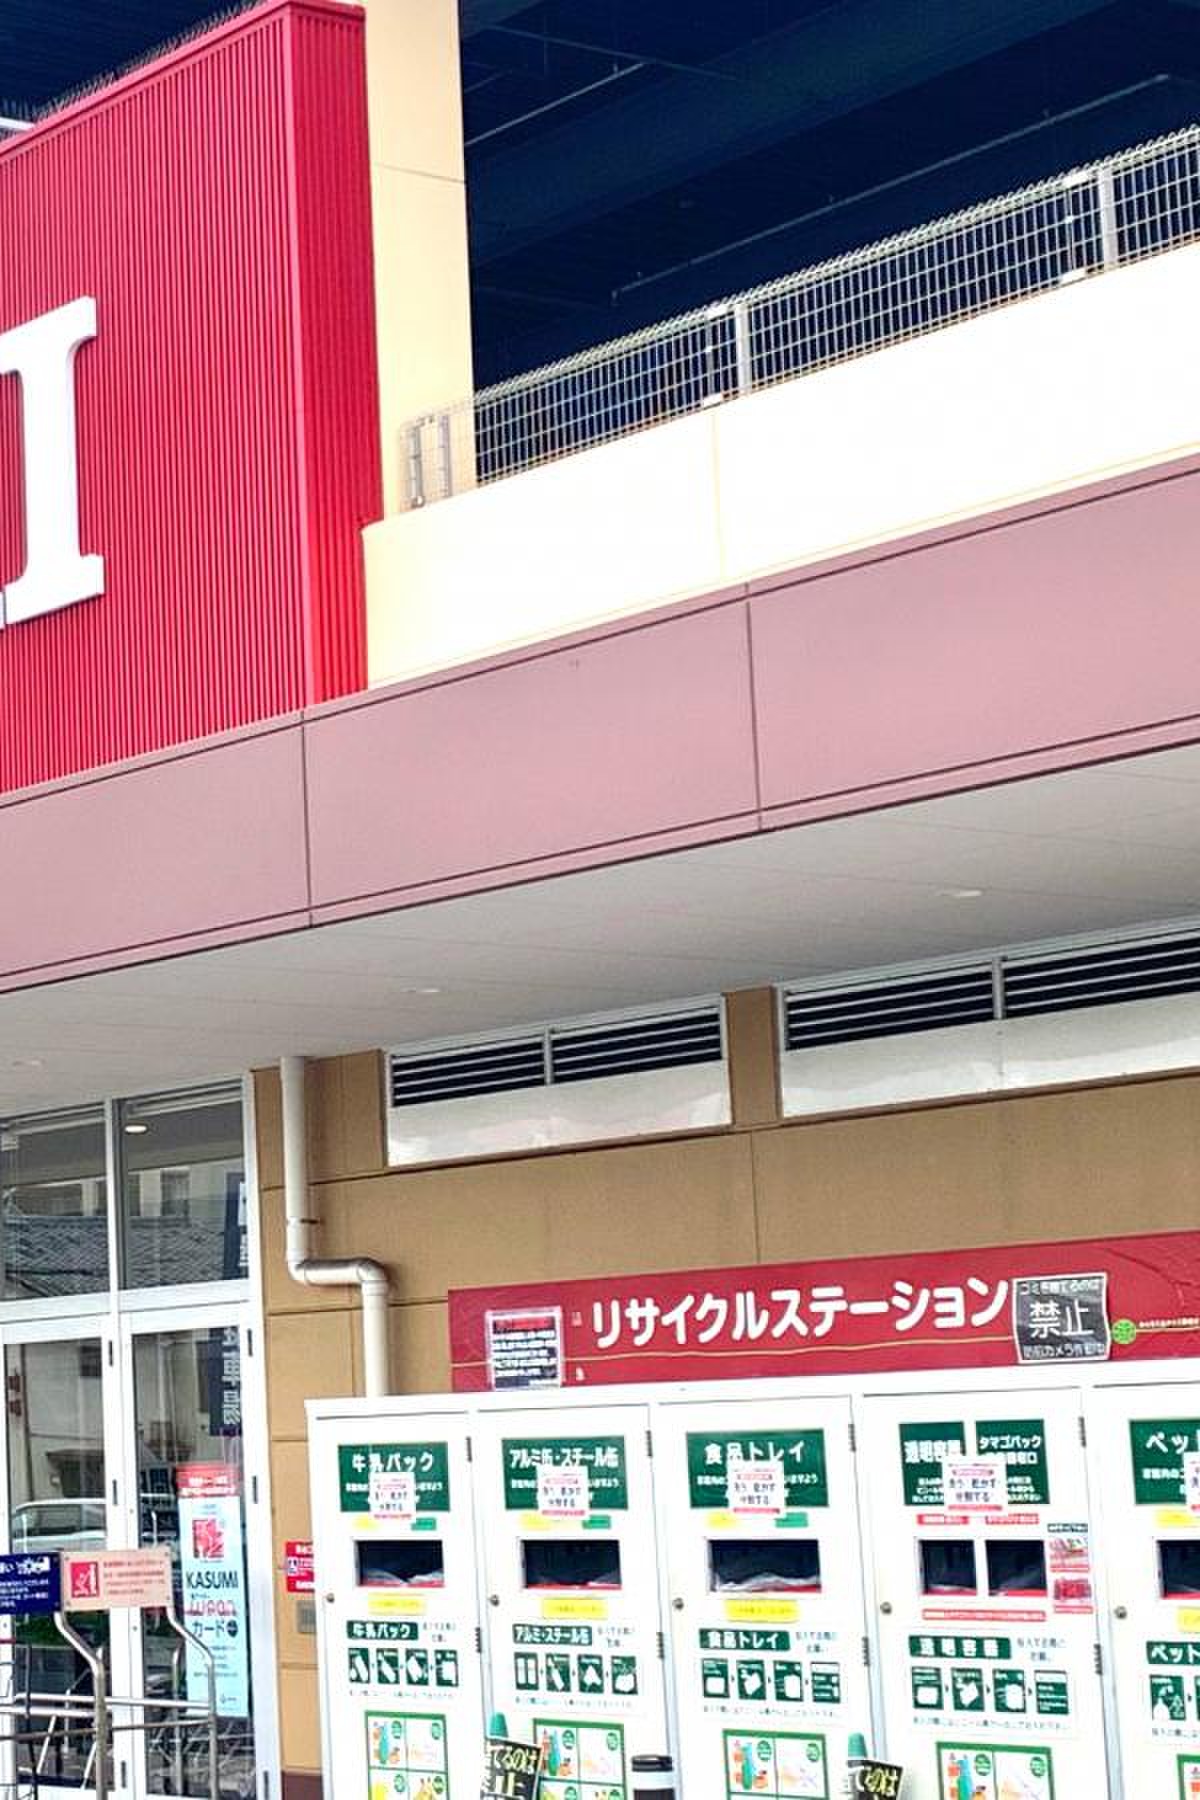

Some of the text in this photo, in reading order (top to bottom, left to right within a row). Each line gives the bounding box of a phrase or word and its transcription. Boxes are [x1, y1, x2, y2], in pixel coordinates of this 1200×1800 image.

[592, 1277, 1009, 1349] リサイクルステーション
[1028, 1299, 1095, 1339] 禁止
[704, 1438, 805, 1466] 食品トレイ
[978, 1434, 1042, 1450] タマゴパック
[1145, 1430, 1200, 1455] ペッ
[351, 1451, 435, 1474] 牛乳パック
[186, 1570, 238, 1589] KASUMI
[192, 1619, 225, 1638] カード
[707, 1630, 779, 1649] 食品トレイ
